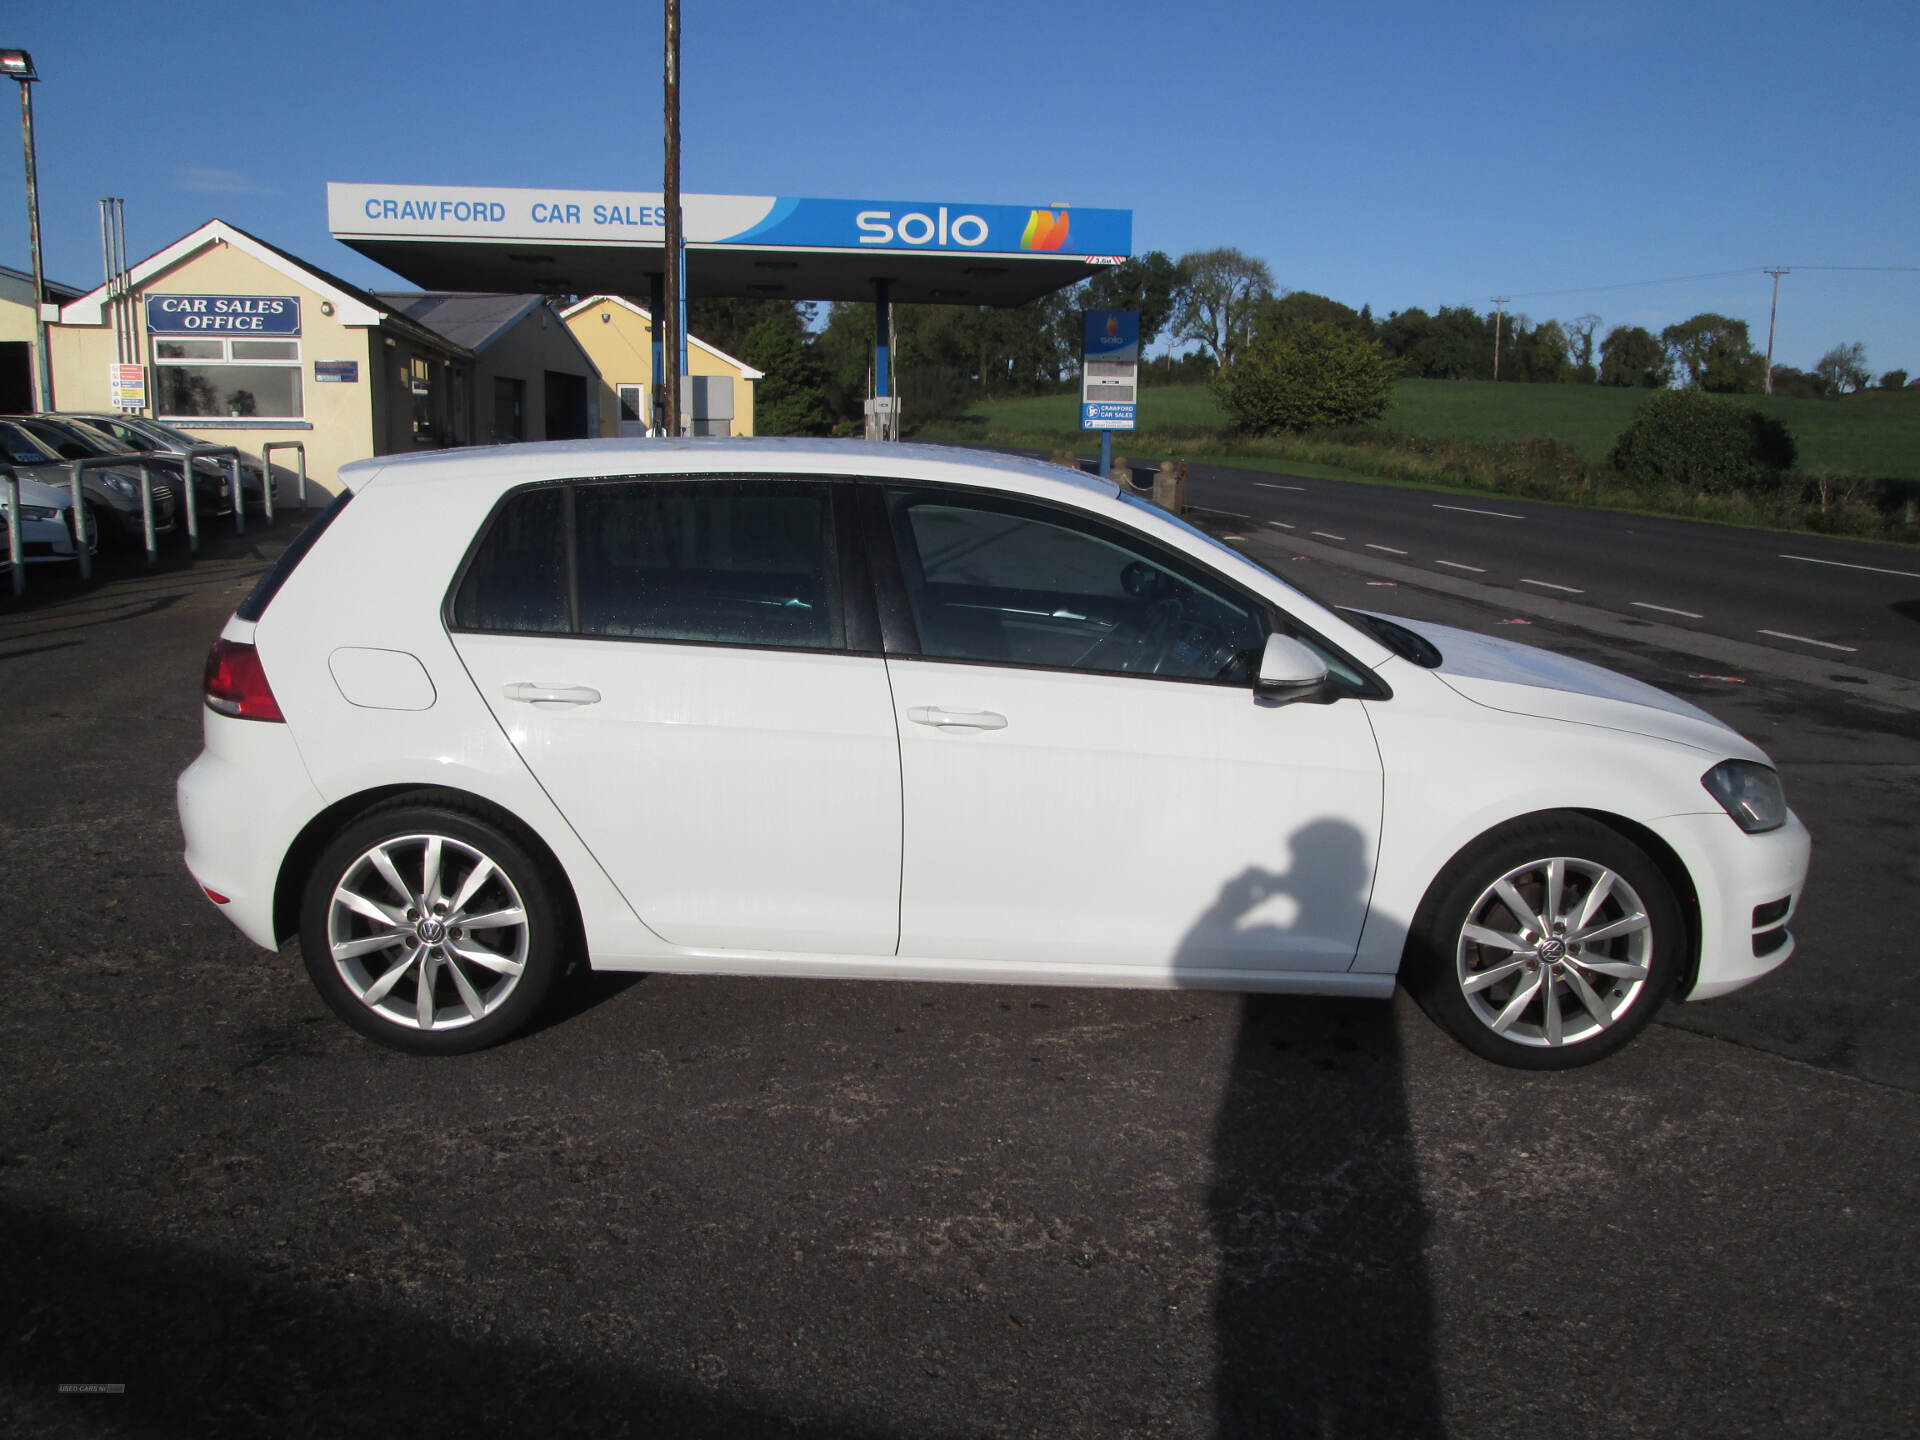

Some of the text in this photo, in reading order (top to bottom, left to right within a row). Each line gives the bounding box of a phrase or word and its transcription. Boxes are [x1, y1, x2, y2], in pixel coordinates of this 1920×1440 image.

[365, 198, 666, 226] CRAWFORD CAR SALES
[856, 207, 989, 246] solo
[162, 299, 284, 314] CAR SALES
[184, 315, 265, 329] OFFICE
[1100, 336, 1123, 344] solo
